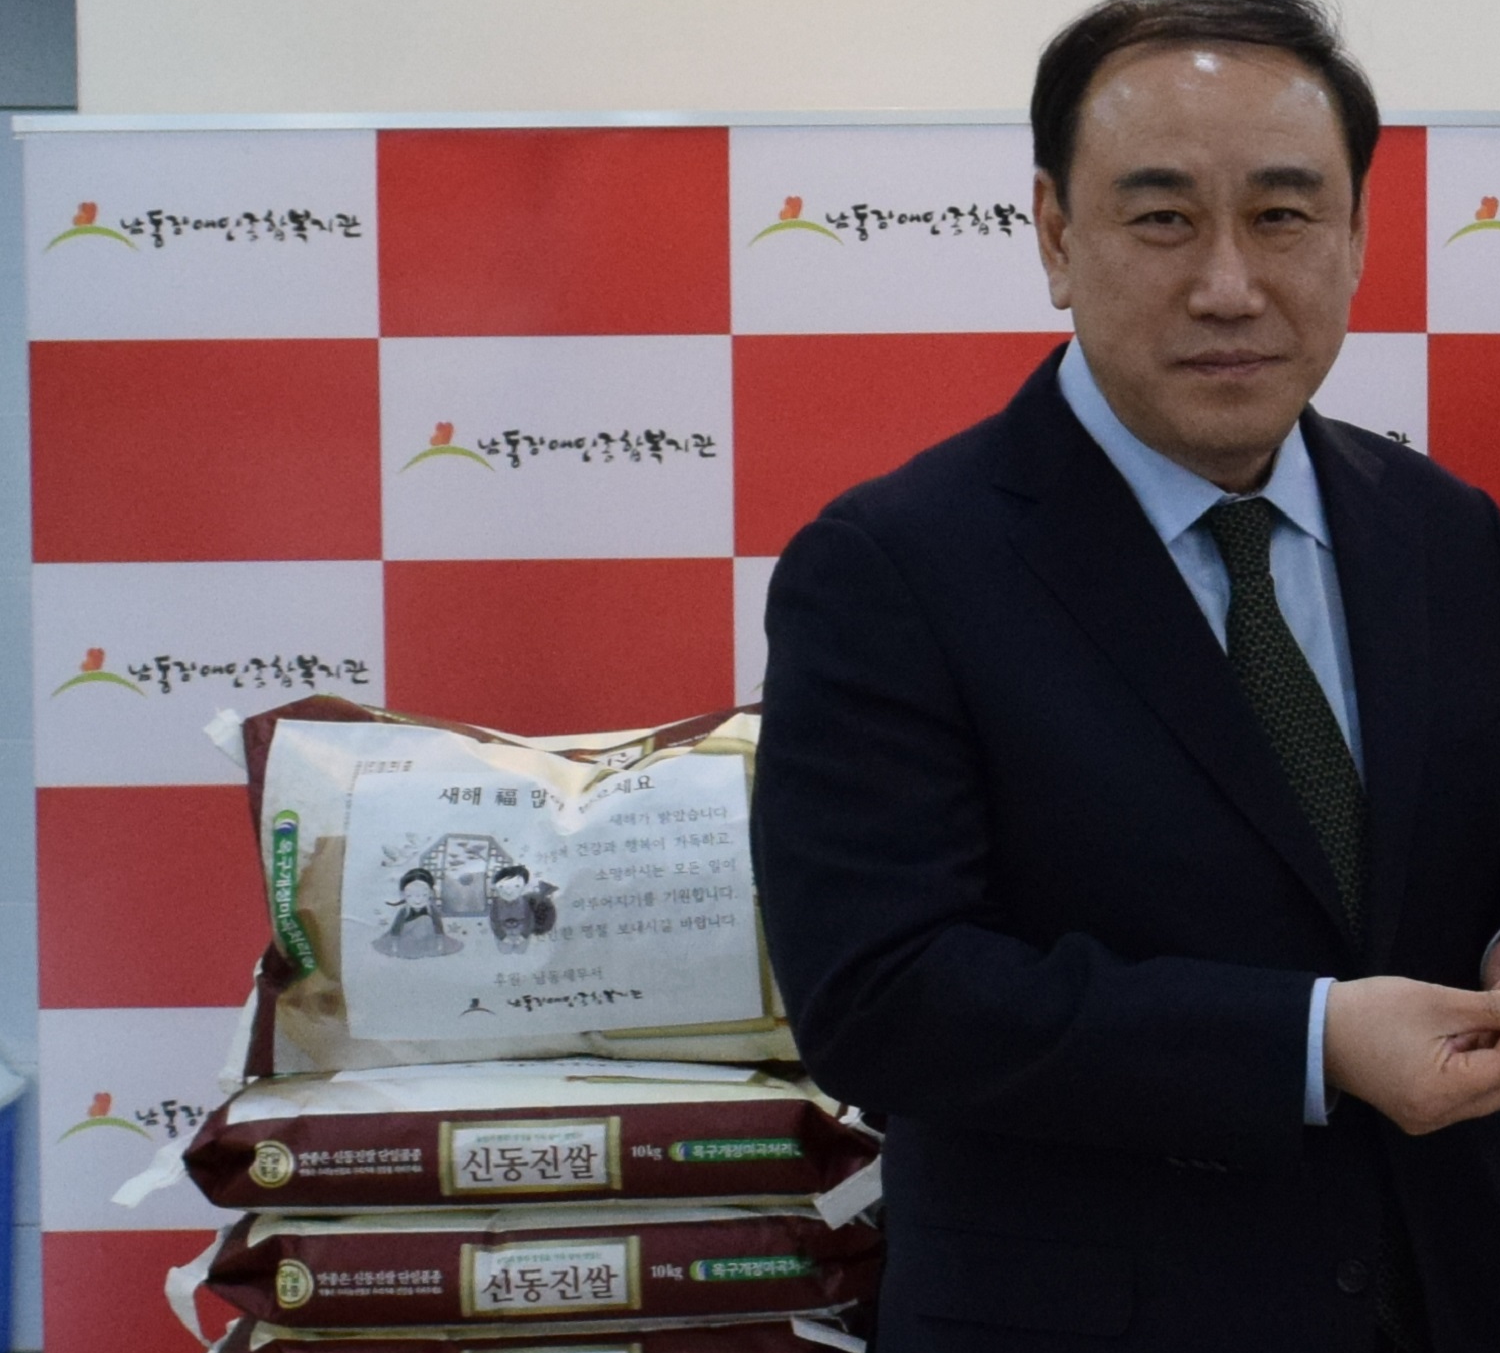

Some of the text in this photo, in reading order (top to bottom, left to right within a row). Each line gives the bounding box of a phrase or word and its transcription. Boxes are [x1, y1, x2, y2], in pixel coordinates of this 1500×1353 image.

[119, 207, 362, 249] 남동장애인종합복지관
[477, 428, 717, 468] 남동장애인종합복지관
[128, 654, 369, 695] 남동장애인종합복지관
[438, 786, 483, 807] 새해
[495, 787, 518, 807] 福
[462, 1144, 598, 1182] 신동진쌀
[481, 1264, 619, 1303] 신동진쌀
